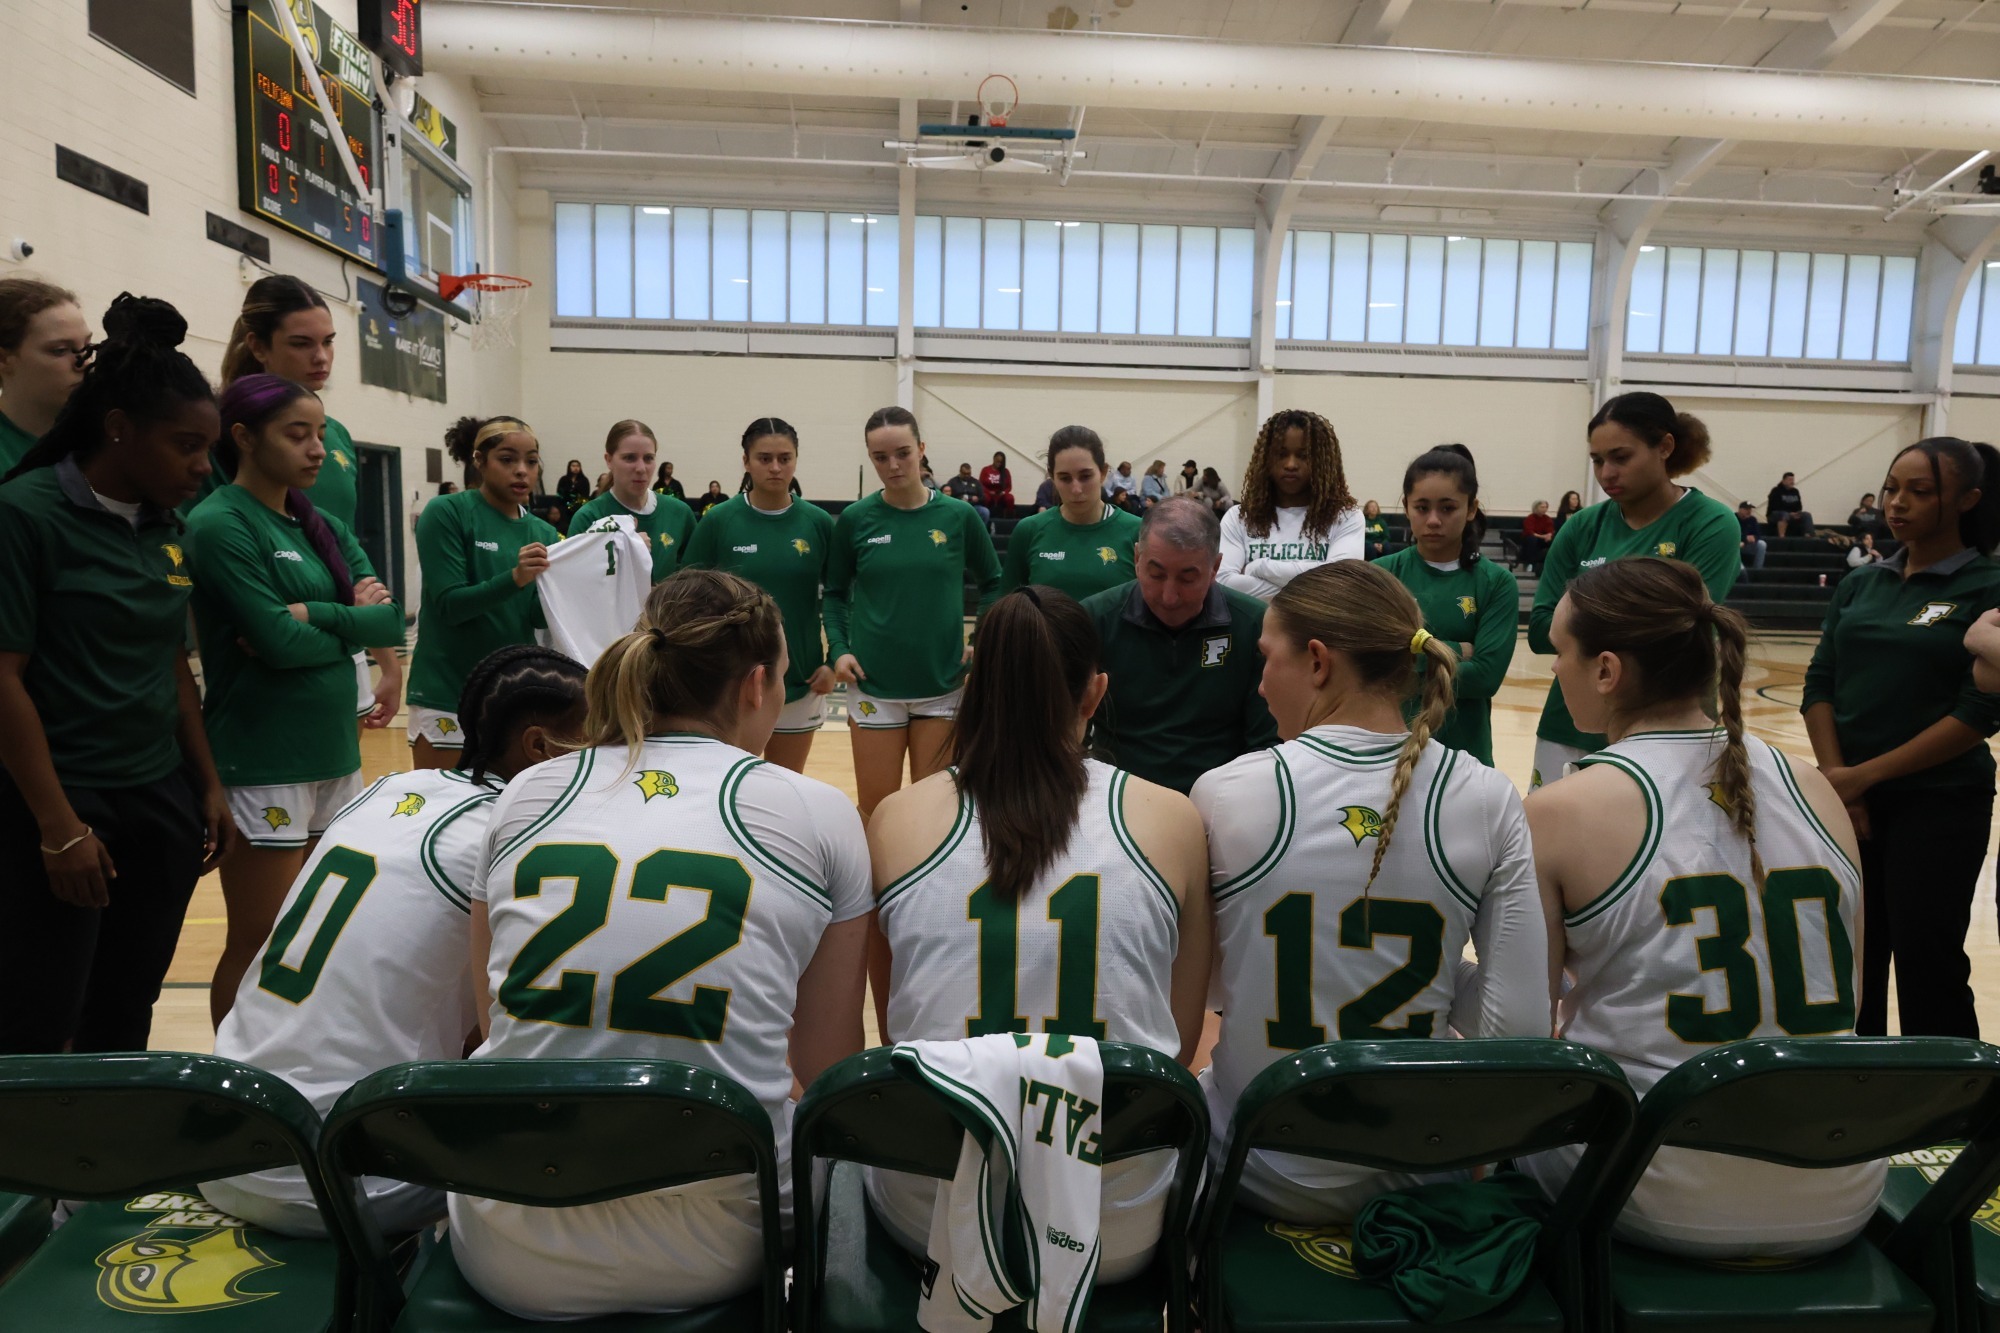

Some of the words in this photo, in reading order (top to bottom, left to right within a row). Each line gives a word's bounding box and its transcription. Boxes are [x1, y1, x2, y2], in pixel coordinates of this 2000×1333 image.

[279, 112, 291, 151] 0
[269, 164, 279, 195] 0
[289, 175, 299, 204] 5
[1249, 543, 1329, 561] FELICIAN
[1203, 635, 1230, 667] F
[258, 844, 378, 1005] 0
[499, 842, 754, 1044] 22
[967, 873, 1107, 1036] 11
[1658, 865, 1857, 1045] 30
[1264, 891, 1446, 1050] 12
[1021, 1077, 1101, 1166] FAL
